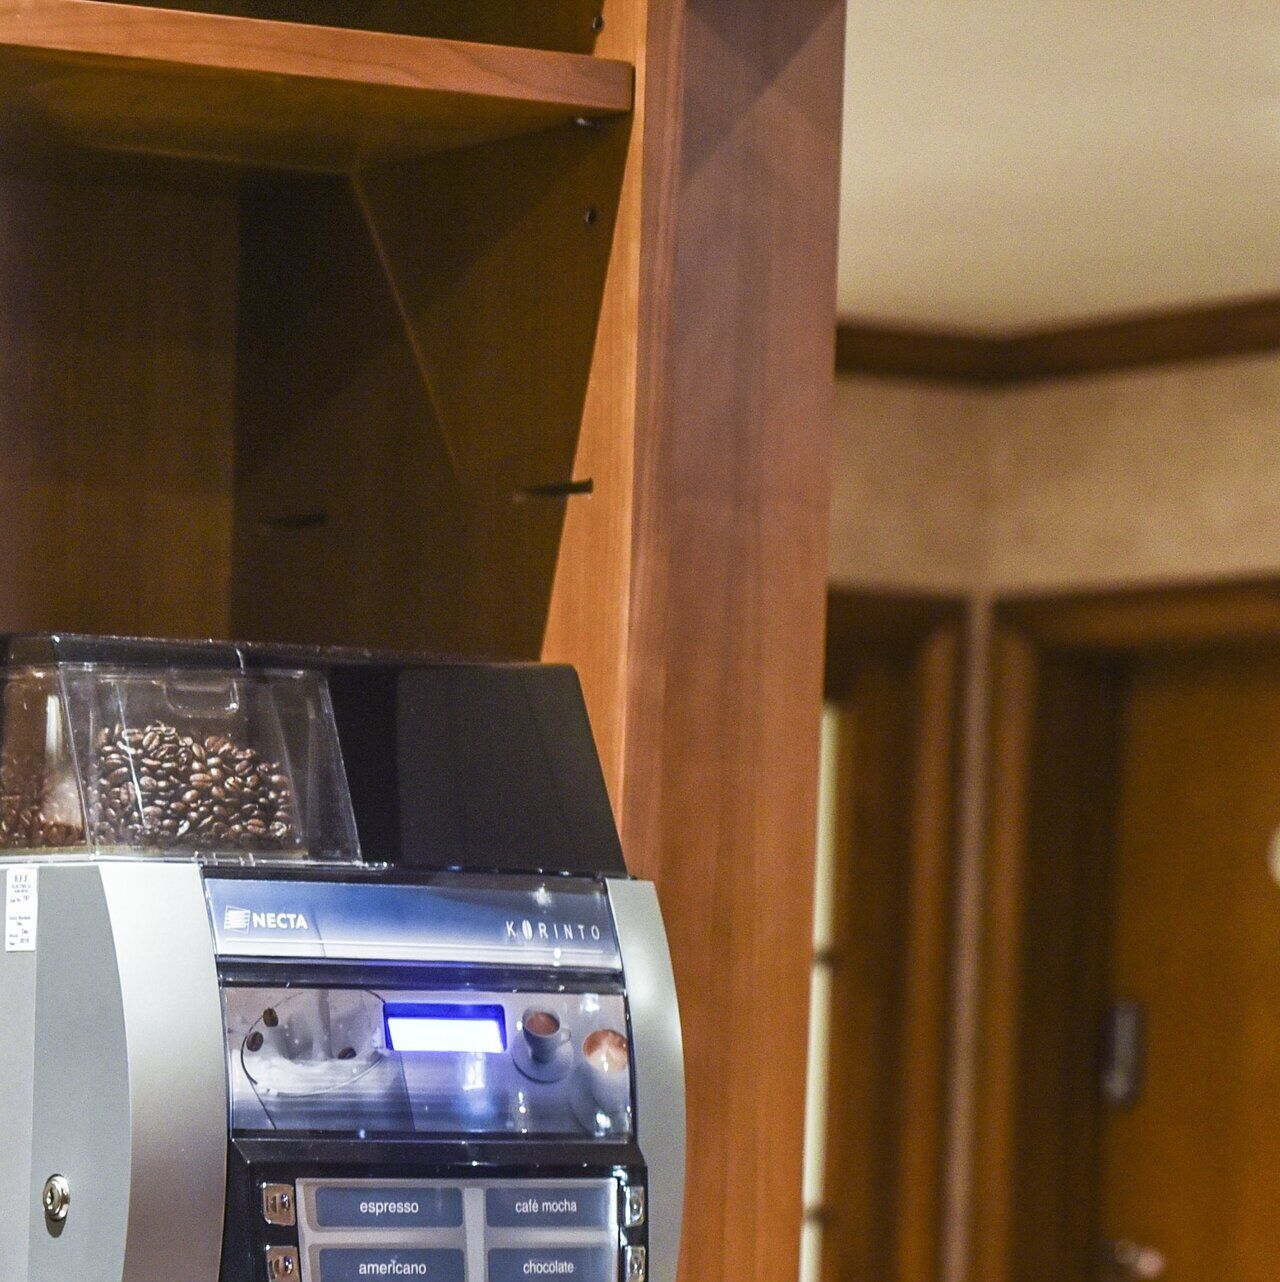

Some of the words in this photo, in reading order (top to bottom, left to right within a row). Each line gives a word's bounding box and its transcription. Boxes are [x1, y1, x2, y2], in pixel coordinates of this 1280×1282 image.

[252, 913, 308, 929] NECTA
[359, 1202, 419, 1215] espresso
[515, 1198, 538, 1214] café
[541, 1199, 577, 1214] mocha
[359, 1259, 427, 1276] americano
[523, 1260, 574, 1275] chocolate
